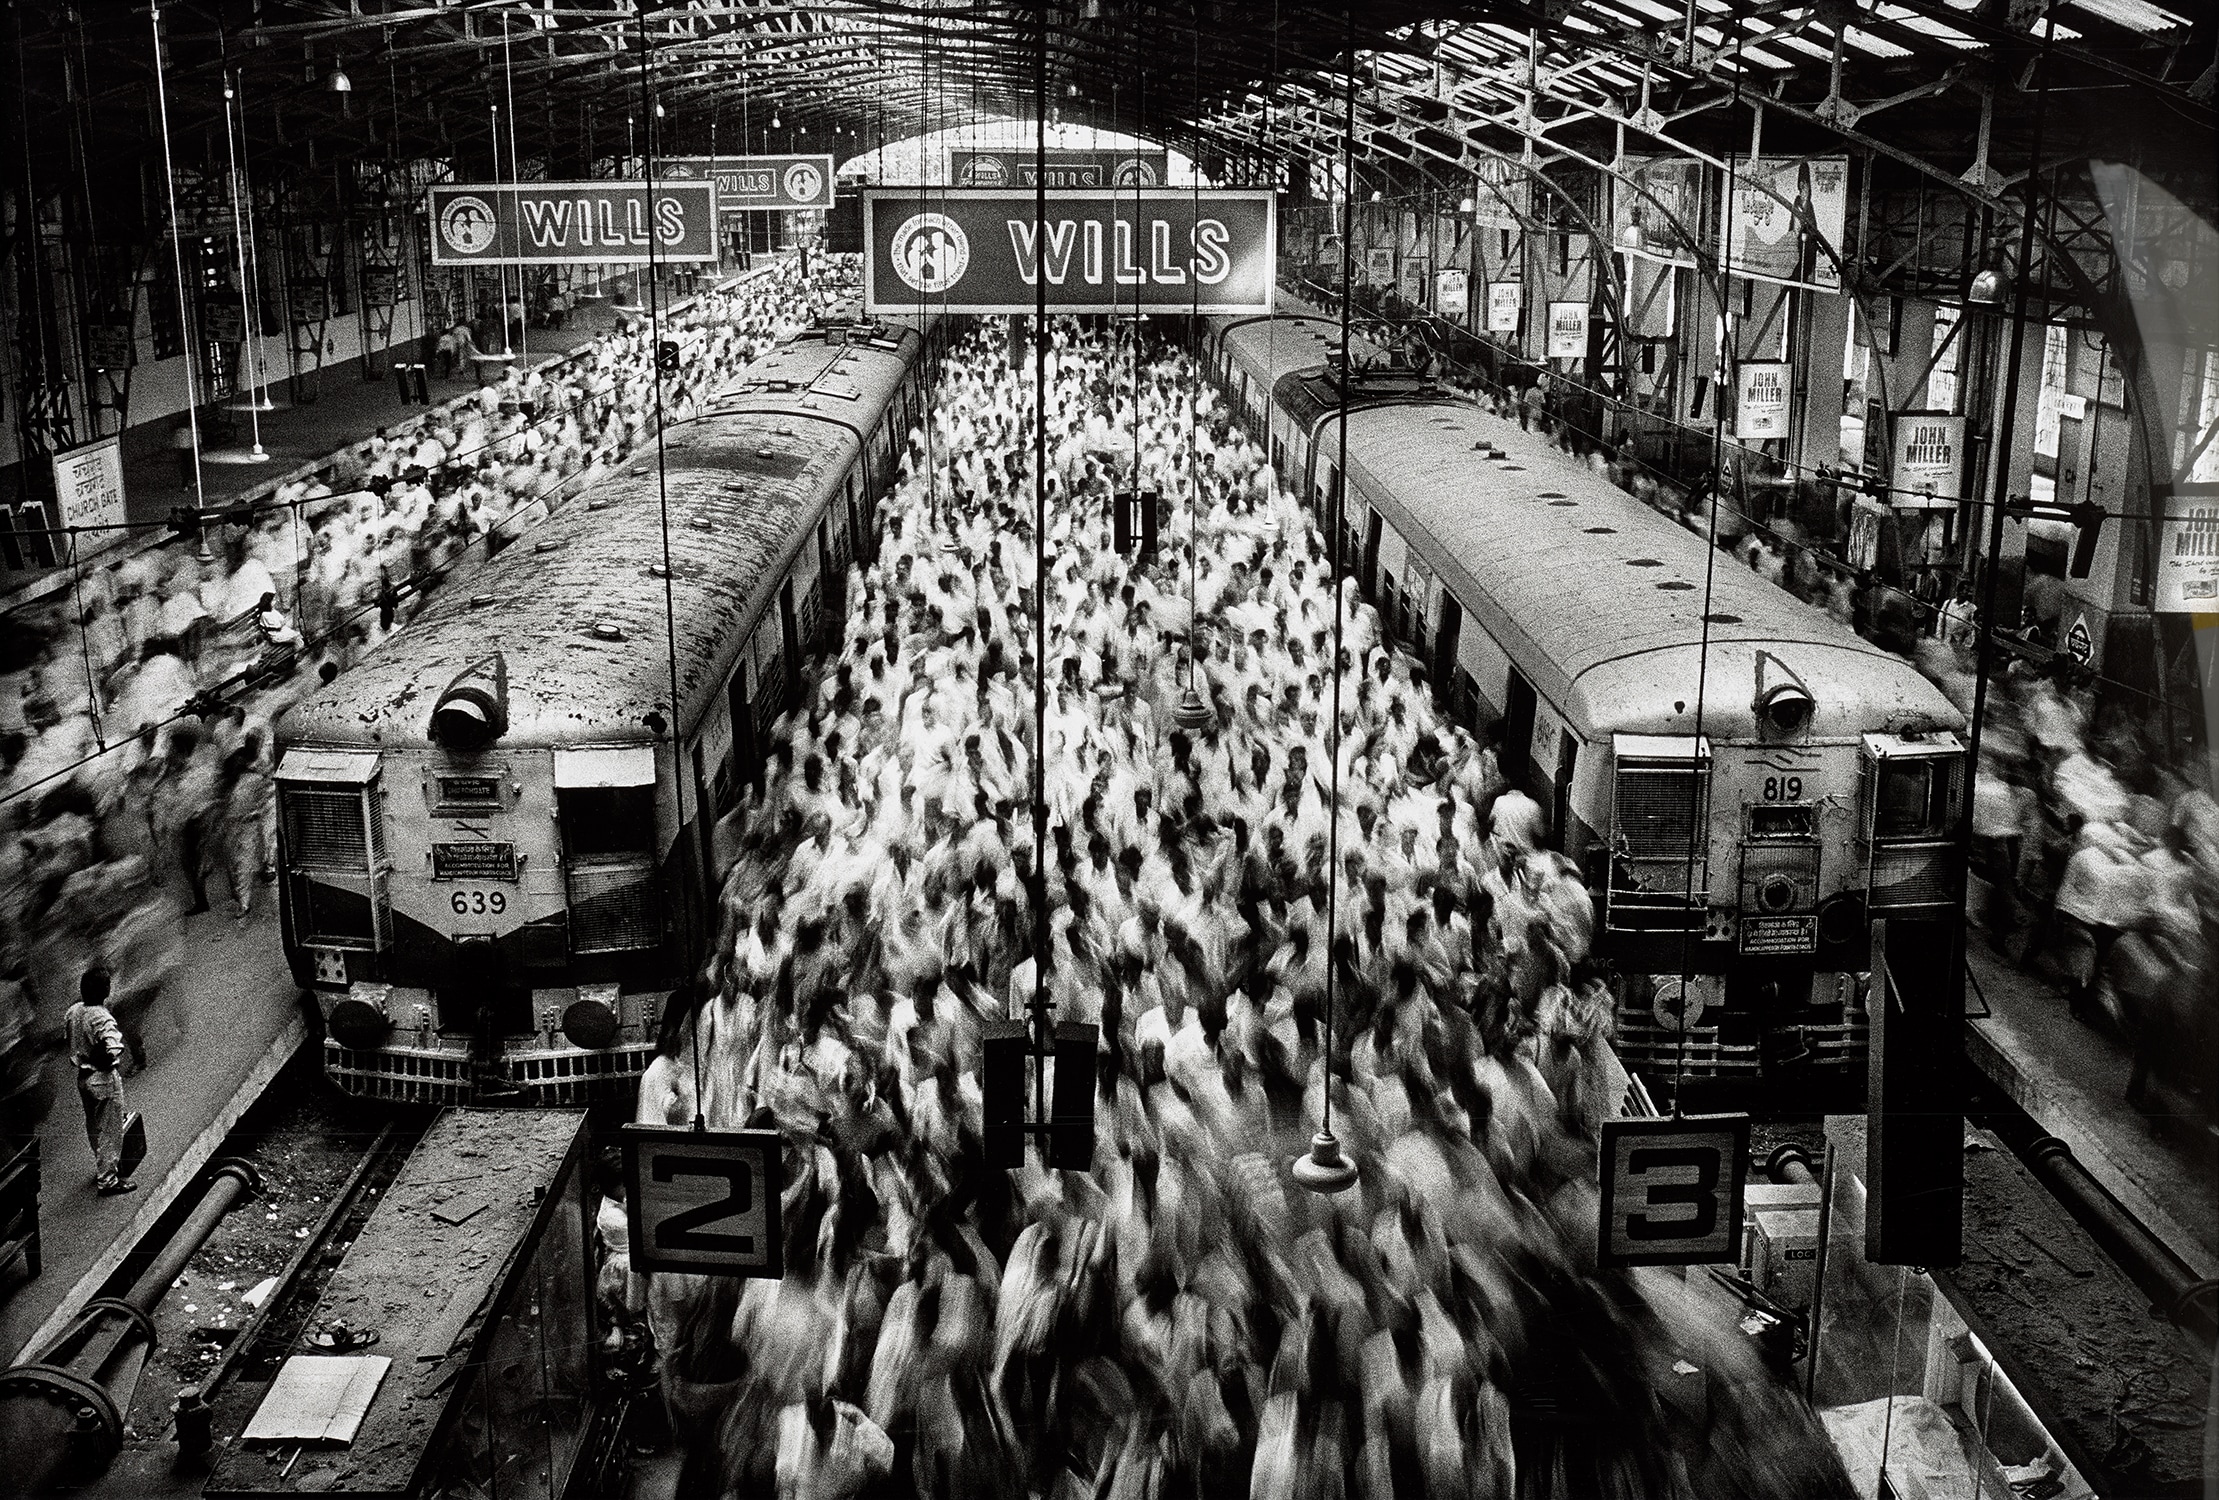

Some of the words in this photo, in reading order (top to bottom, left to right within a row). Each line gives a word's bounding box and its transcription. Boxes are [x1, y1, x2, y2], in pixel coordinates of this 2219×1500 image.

[718, 174, 770, 192] WILLS
[521, 197, 686, 247] WILLS
[1007, 219, 1230, 285] WILLS
[1560, 309, 1579, 320] JOHN
[1556, 320, 1582, 331] MILLER
[1753, 372, 1778, 388] JOHN
[1748, 388, 1782, 402] MILLER
[1913, 426, 1946, 445] JOHN
[1906, 445, 1951, 463] MILLER
[67, 497, 100, 521] CHURCH
[1763, 776, 1802, 801] 819
[451, 891, 506, 914] 639
[1626, 1146, 1720, 1241] 3
[652, 1154, 755, 1255] 2
